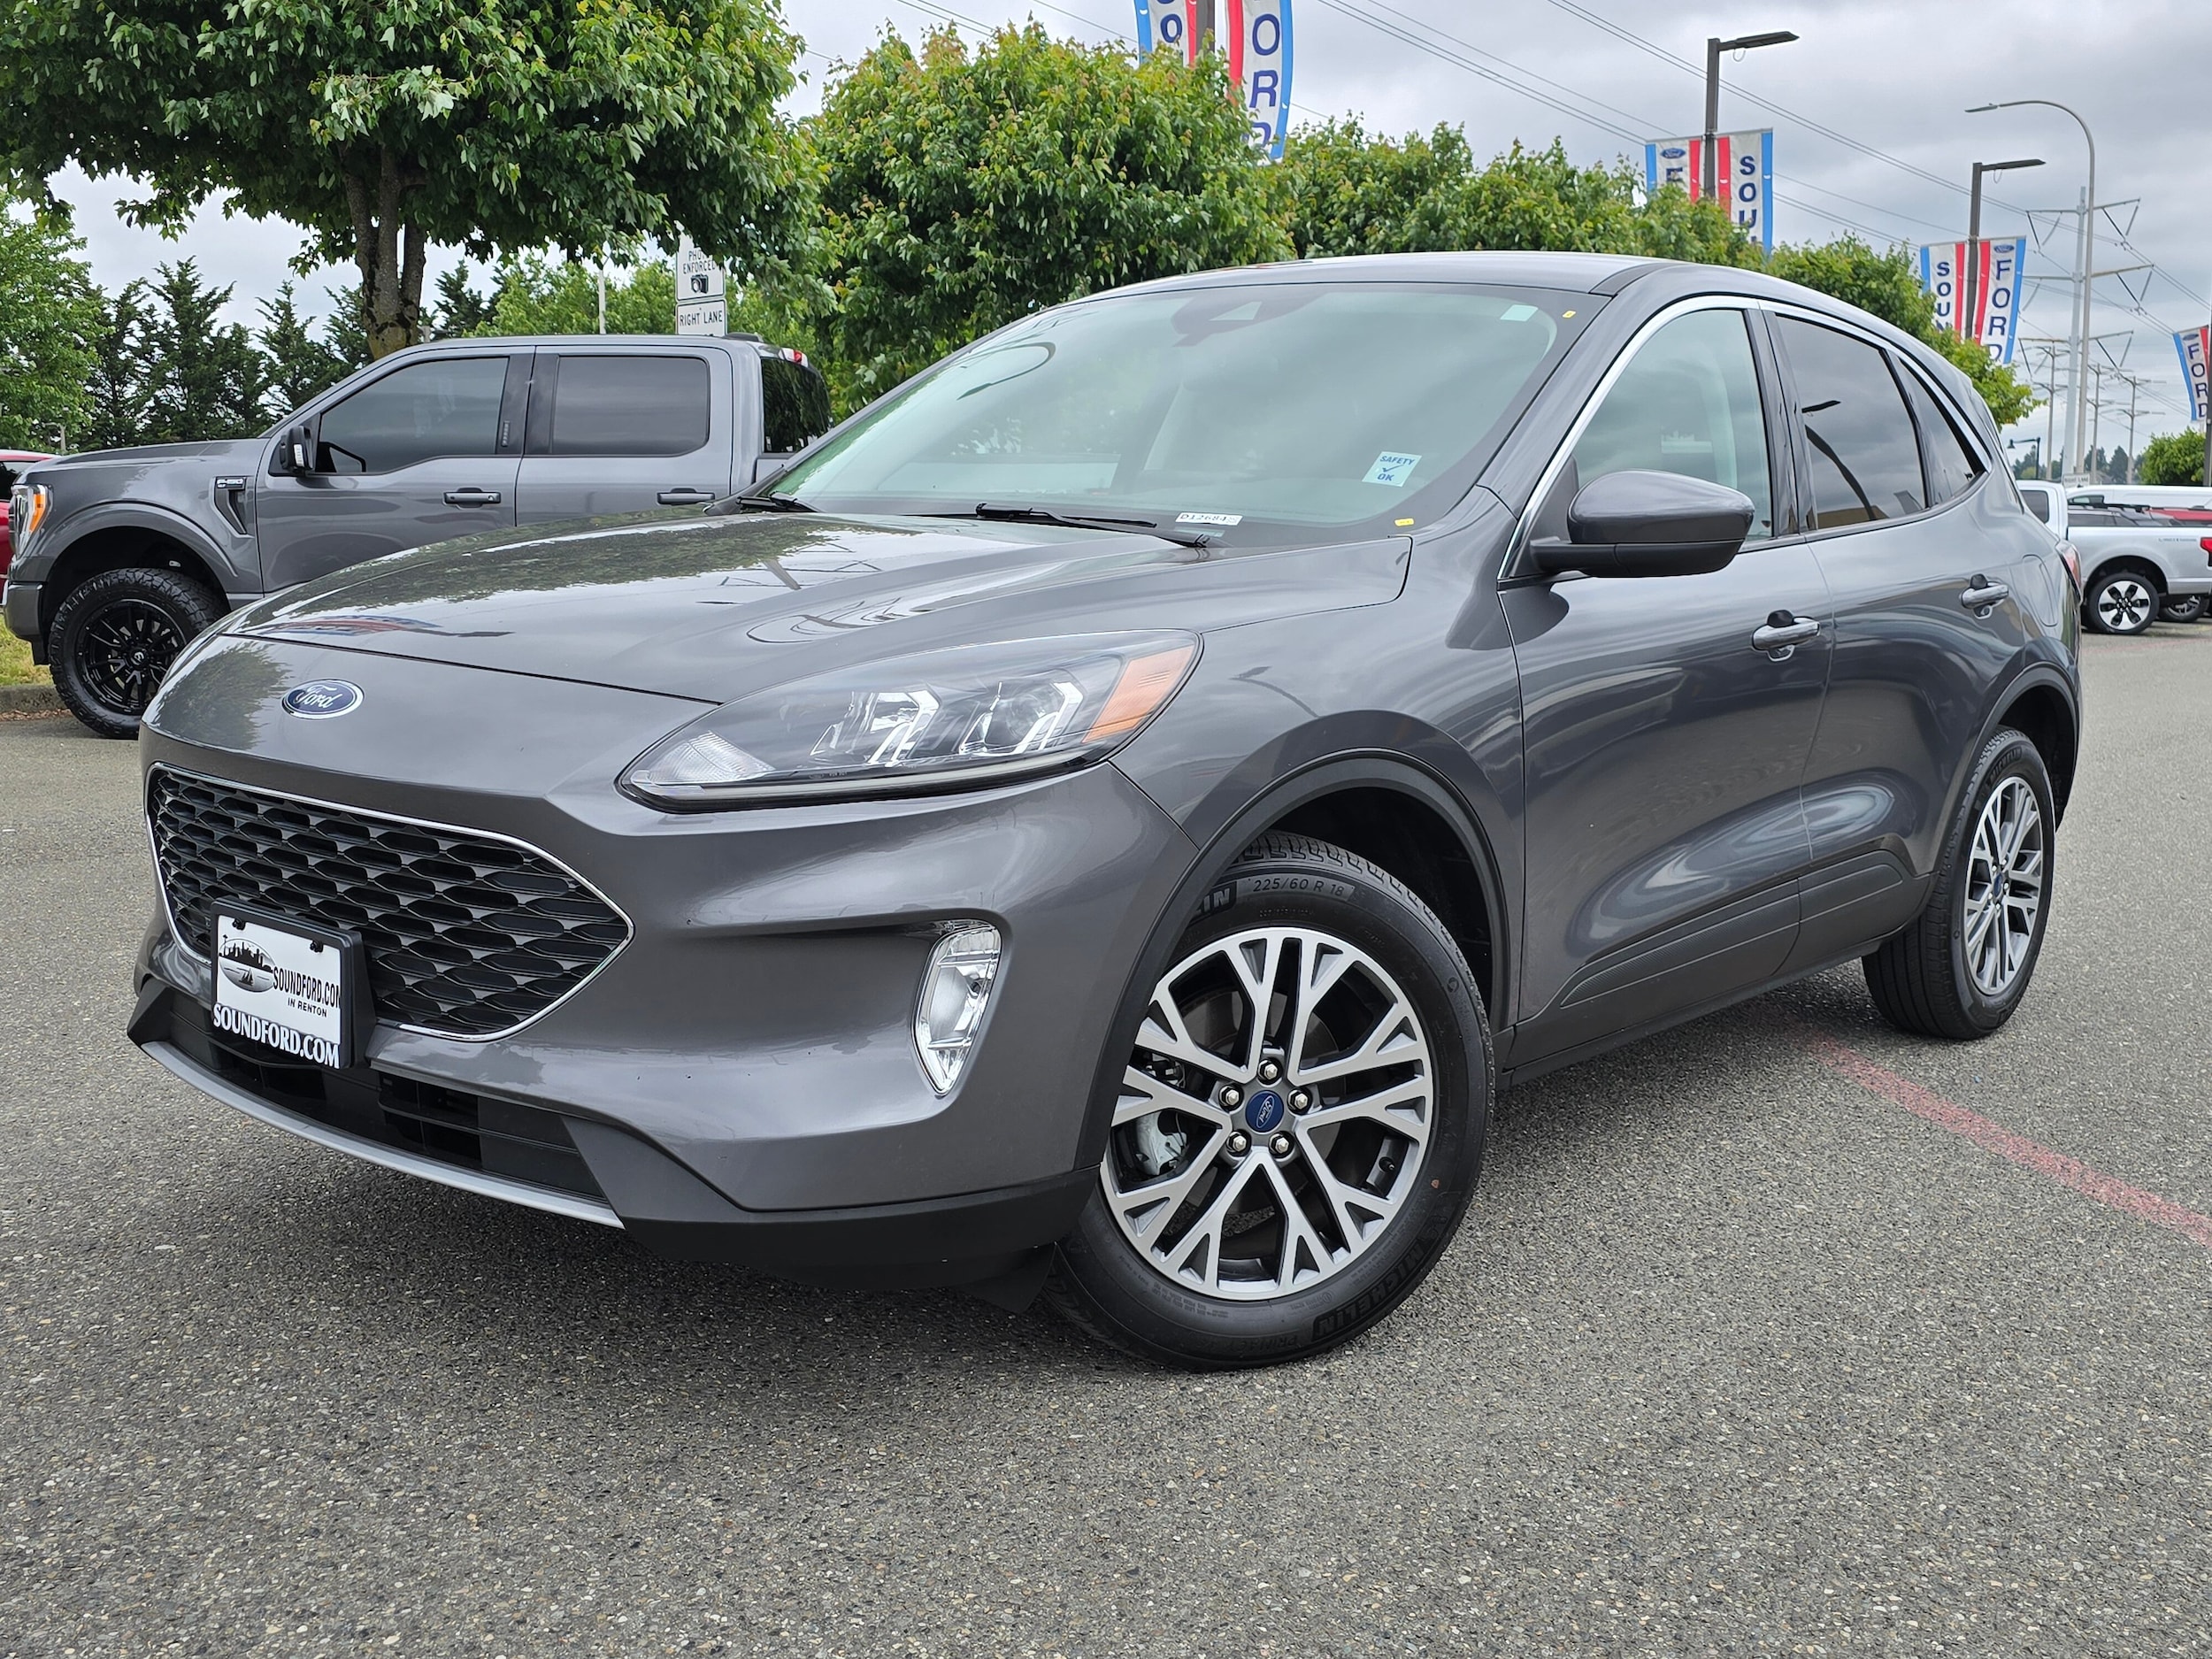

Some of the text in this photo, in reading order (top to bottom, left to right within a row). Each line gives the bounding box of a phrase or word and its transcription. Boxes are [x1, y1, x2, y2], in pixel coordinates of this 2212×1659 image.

[1245, 0, 1280, 149] ORD
[1738, 156, 1757, 242] SOU
[680, 310, 723, 327] RIGHT LANE
[2187, 343, 2208, 418] FORD
[1379, 455, 1415, 465] SAFETY
[1377, 472, 1395, 481] OK
[293, 685, 342, 709] Ford
[1253, 878, 1345, 896] 225/60 R 18
[288, 997, 327, 1018] IN RENTON
[212, 1003, 341, 1069] SOUNDFORD.COM
